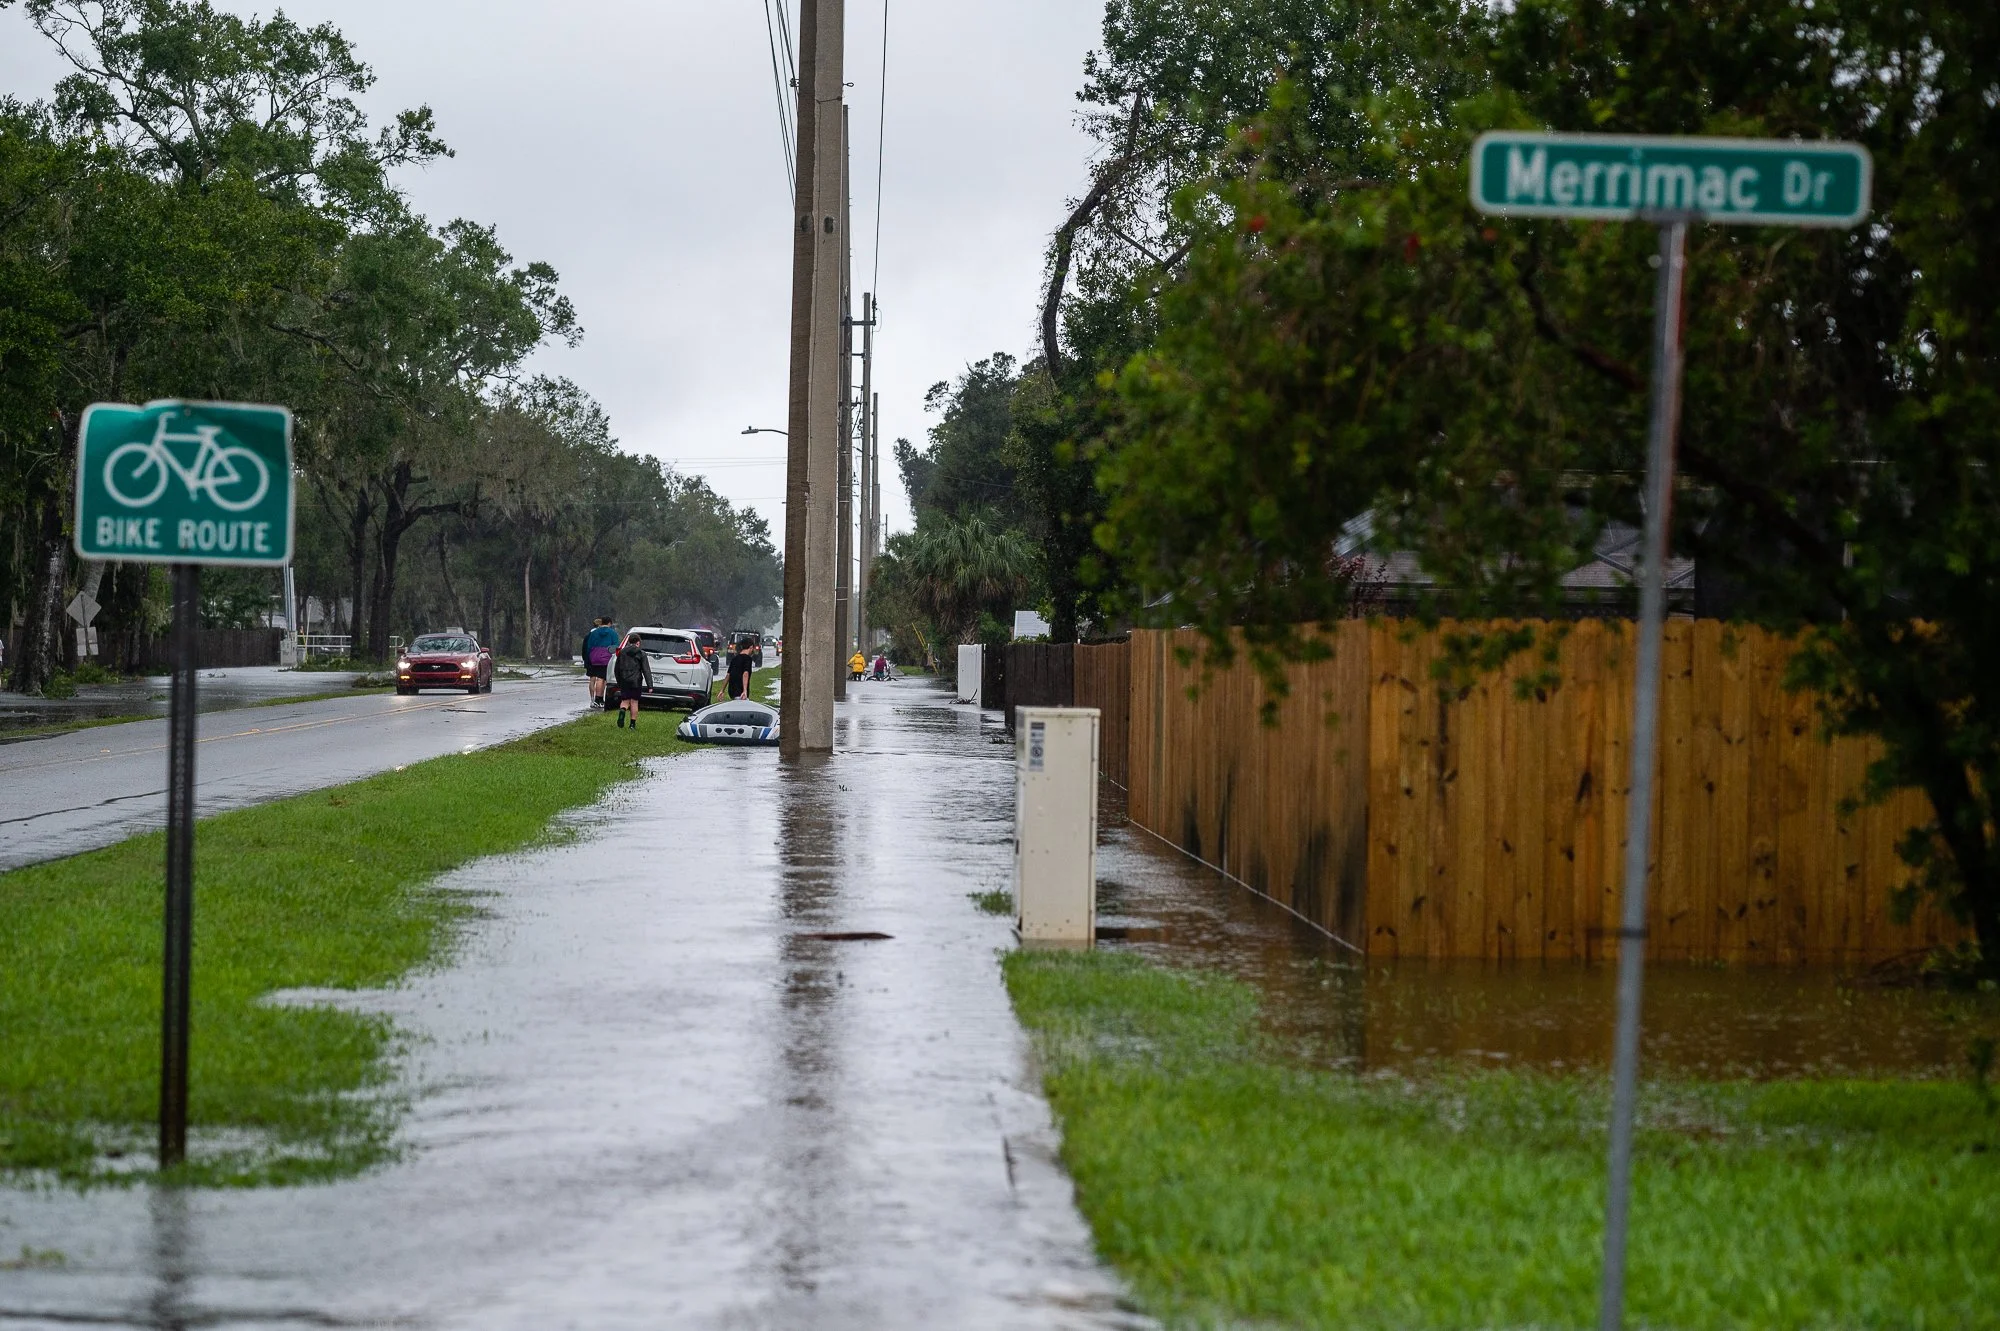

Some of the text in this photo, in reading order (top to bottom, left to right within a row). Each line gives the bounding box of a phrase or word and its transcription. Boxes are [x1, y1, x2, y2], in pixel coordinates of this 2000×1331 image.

[1505, 145, 1835, 209] Merrimac Dr
[96, 516, 271, 553] BIKE ROUTE
